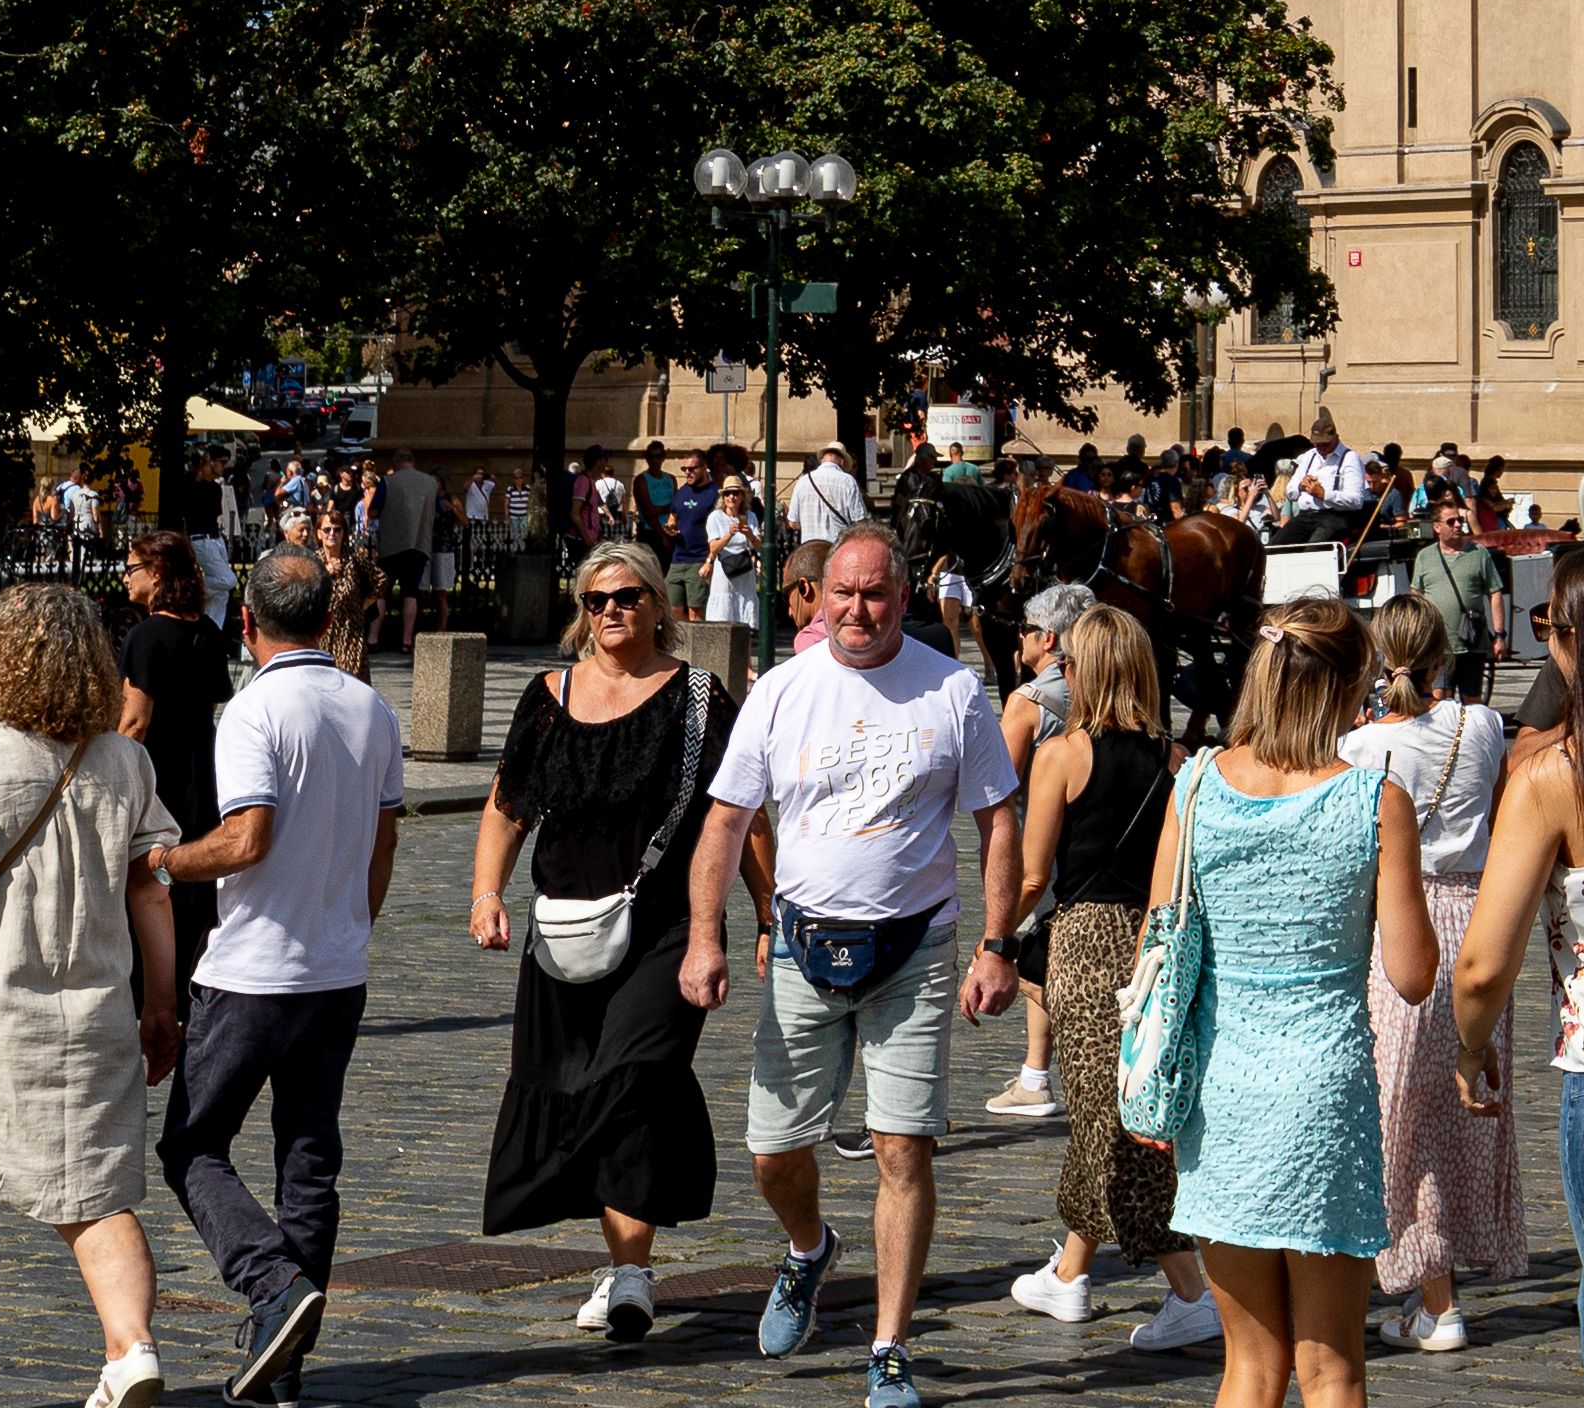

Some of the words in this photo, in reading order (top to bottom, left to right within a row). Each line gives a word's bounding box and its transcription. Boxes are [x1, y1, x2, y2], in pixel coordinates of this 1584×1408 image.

[816, 726, 918, 771] BEST
[818, 760, 916, 802] 1966
[819, 794, 916, 836] YEAR
